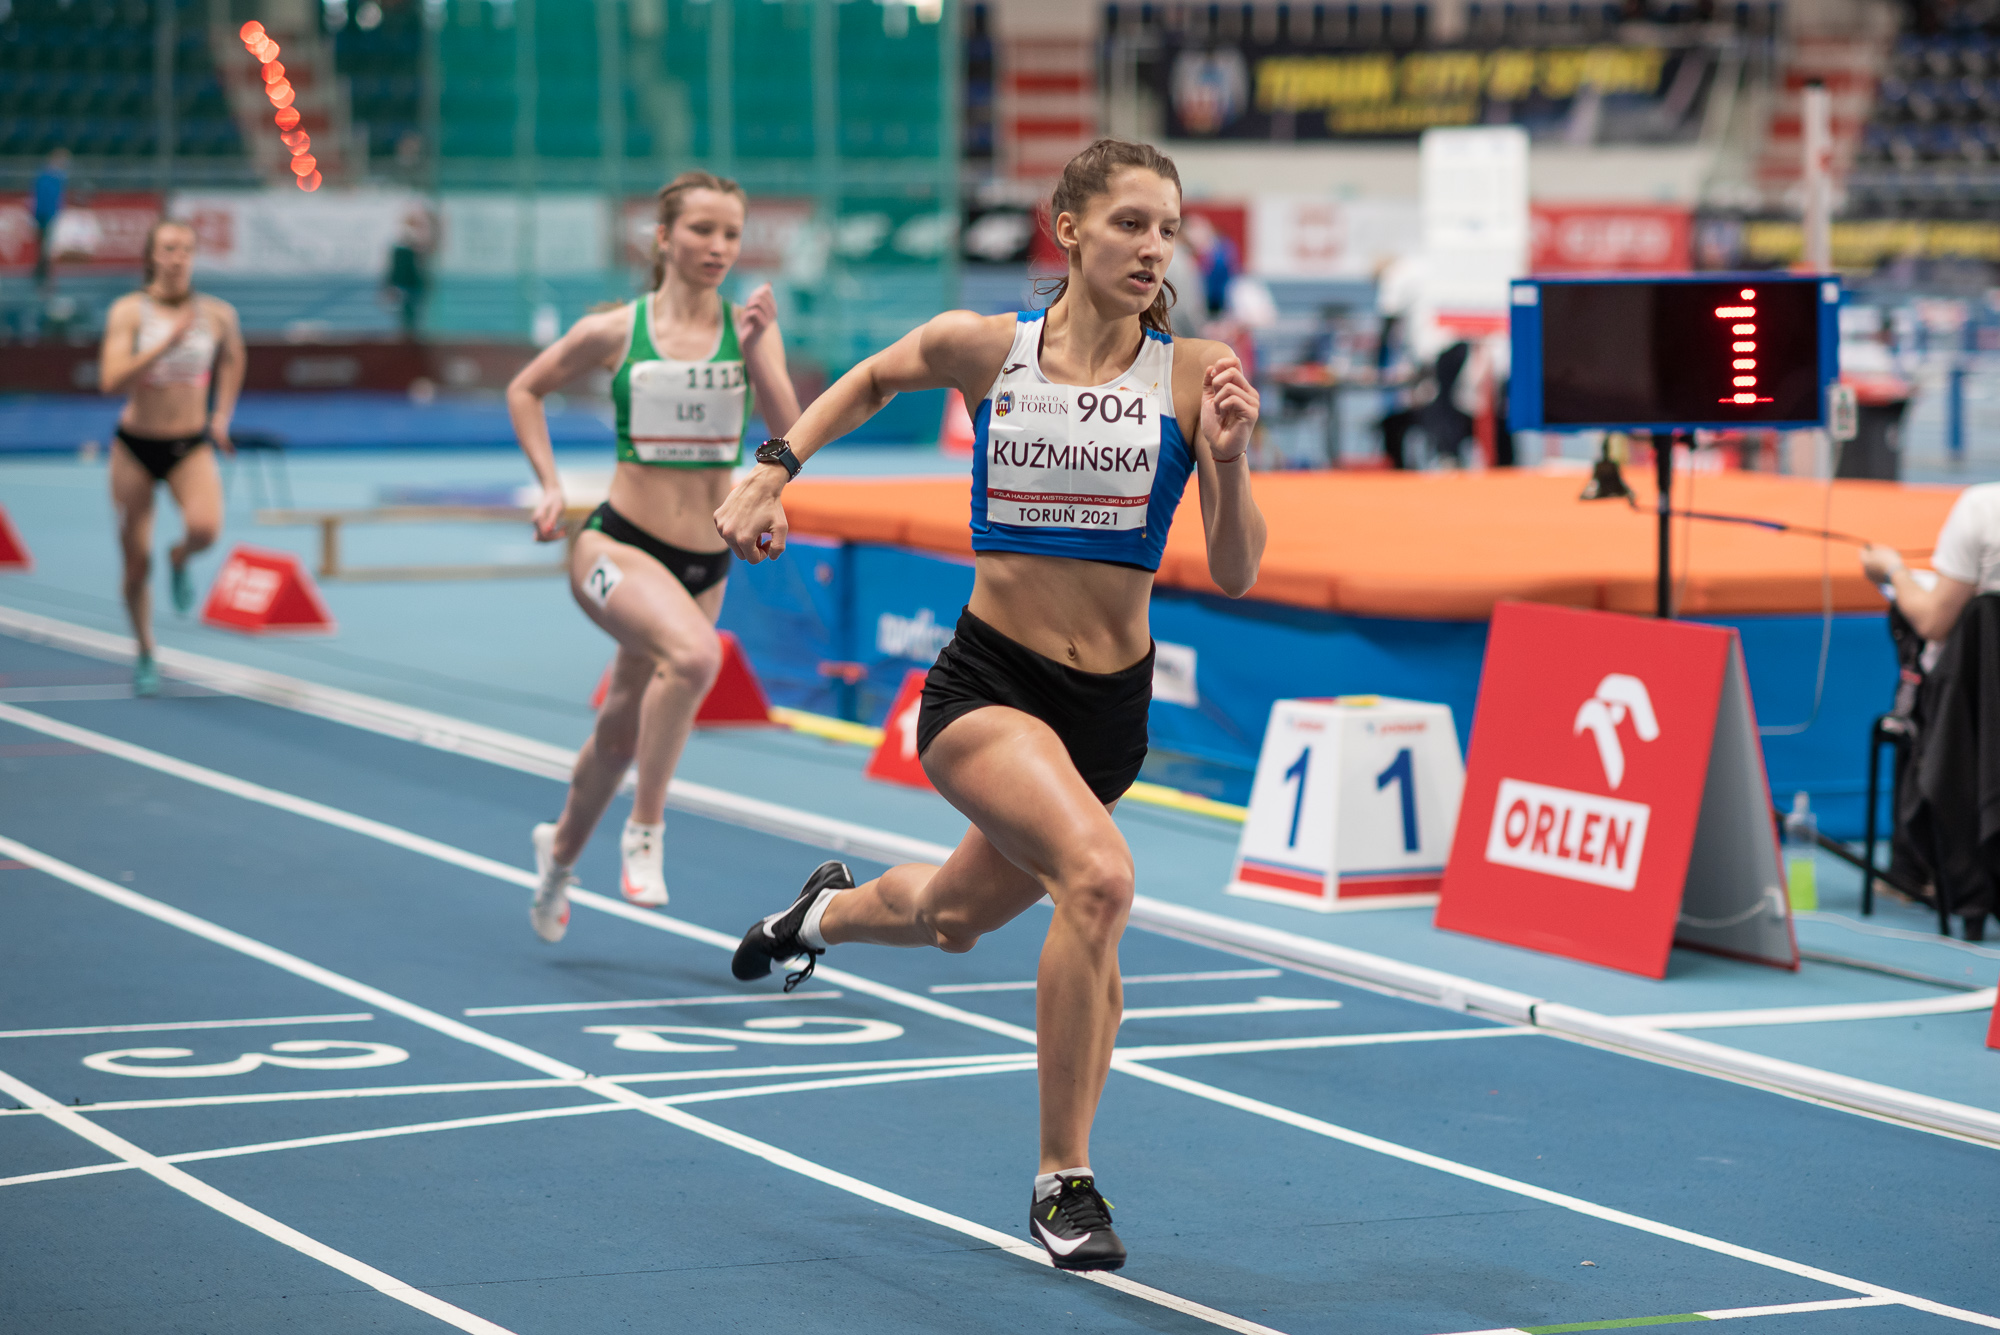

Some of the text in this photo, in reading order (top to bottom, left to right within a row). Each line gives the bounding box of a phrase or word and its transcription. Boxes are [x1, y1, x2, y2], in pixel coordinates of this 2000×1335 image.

[1715, 289, 1774, 404] 1
[677, 403, 706, 421] LIS
[1019, 400, 1068, 415] TORUŃ
[1021, 394, 1059, 402] MIASTO
[1077, 392, 1147, 425] 904
[993, 438, 1150, 472] KUŹMIŃSKA
[1019, 505, 1118, 526] TORUŃ 2021
[590, 569, 614, 599] 2
[1284, 745, 1311, 848] 1
[1376, 747, 1419, 852] 1
[1504, 799, 1633, 870] ORLEN
[582, 1016, 905, 1053] 2
[82, 1039, 410, 1078] 3
